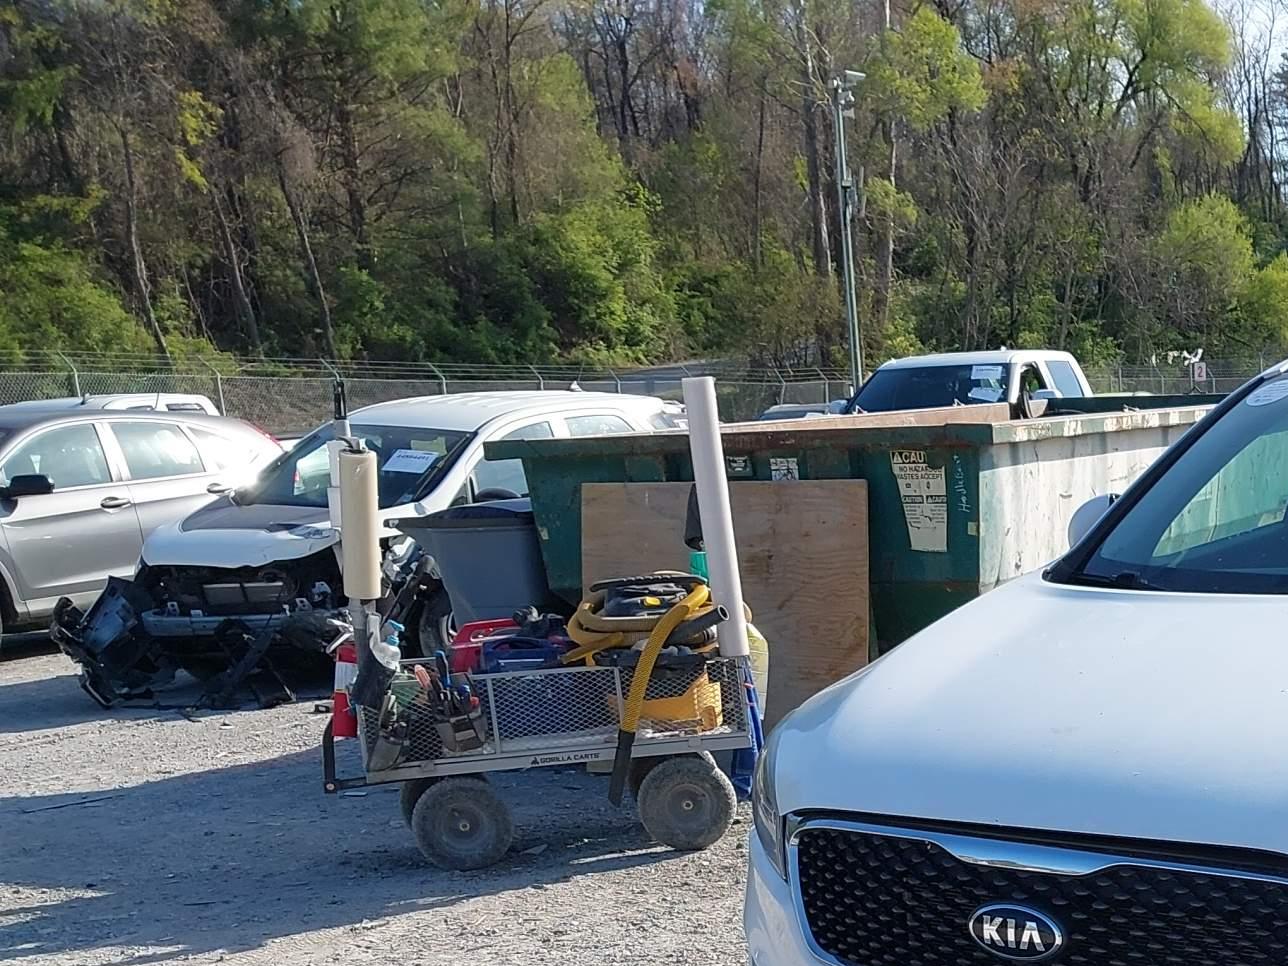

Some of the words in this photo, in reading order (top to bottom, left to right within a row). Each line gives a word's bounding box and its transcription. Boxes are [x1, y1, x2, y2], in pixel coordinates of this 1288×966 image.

[1196, 366, 1203, 378] 2
[573, 752, 600, 760] CARTS
[983, 915, 1045, 952] KIA
